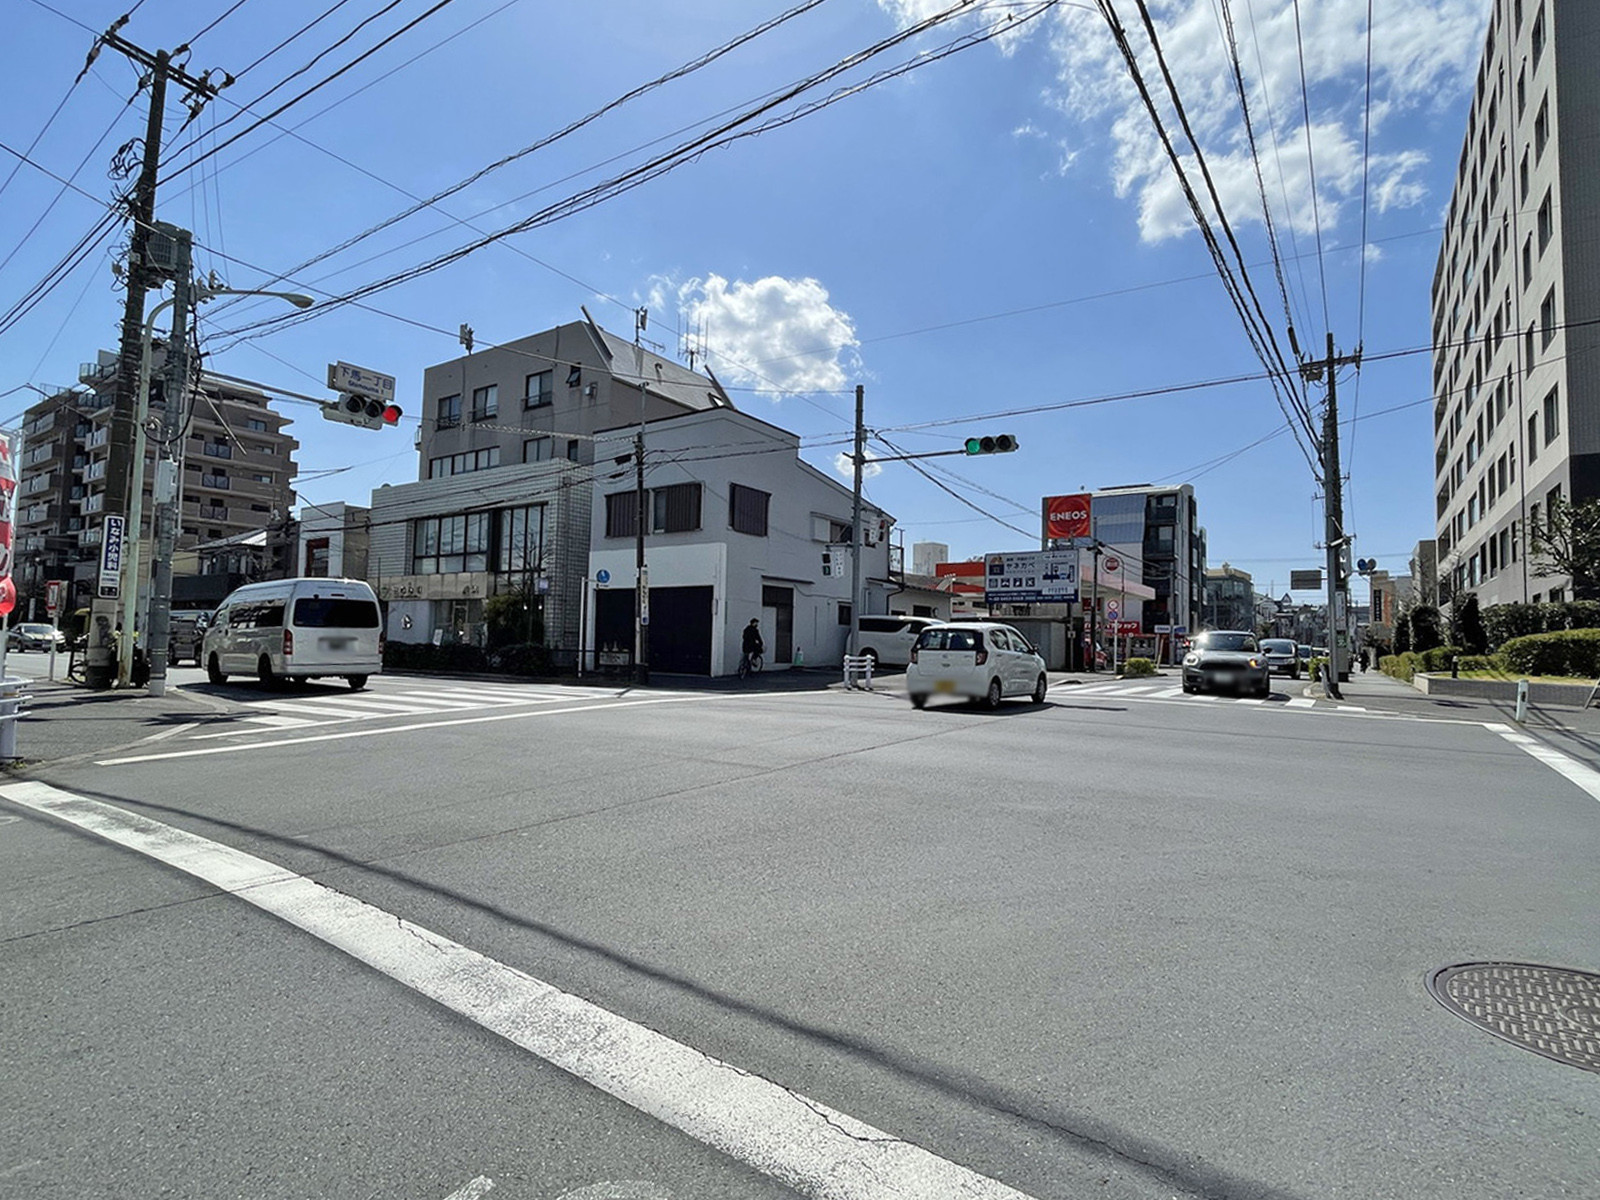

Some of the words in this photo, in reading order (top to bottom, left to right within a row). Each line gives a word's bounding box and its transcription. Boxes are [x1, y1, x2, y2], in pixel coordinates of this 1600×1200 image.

[341, 366, 392, 390] 下馬一丁目
[1050, 510, 1087, 521] ENEOS
[107, 519, 121, 570] いなみ小児科
